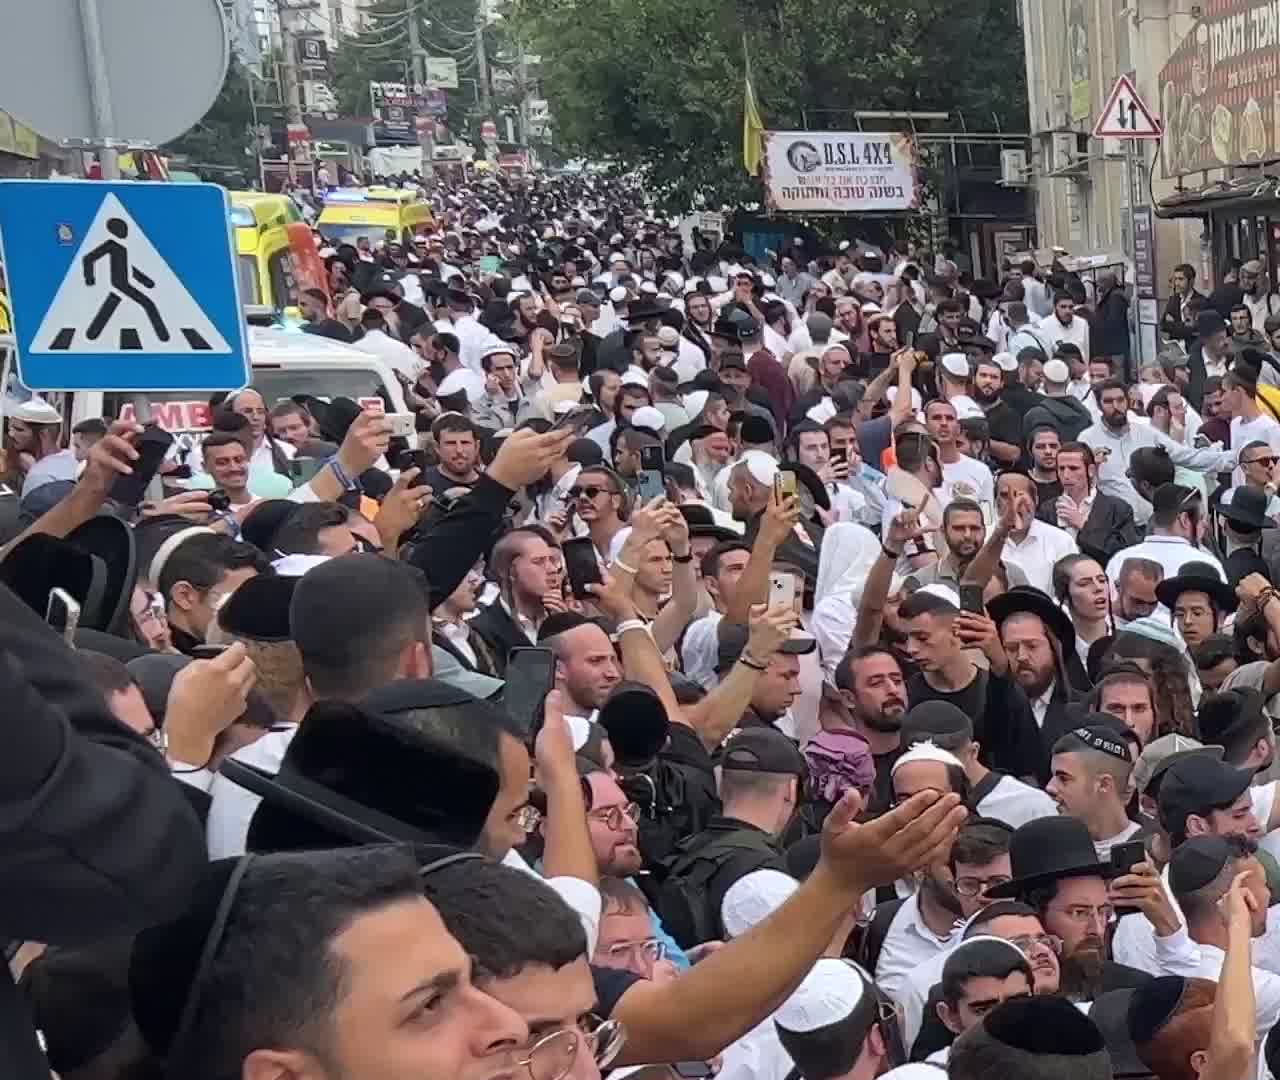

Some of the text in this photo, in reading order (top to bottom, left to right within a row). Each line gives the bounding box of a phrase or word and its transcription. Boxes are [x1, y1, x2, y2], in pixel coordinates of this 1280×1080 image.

[824, 142, 893, 166] D.S.L 4X4
[782, 185, 905, 200] בשנה טובה ומתוקה
